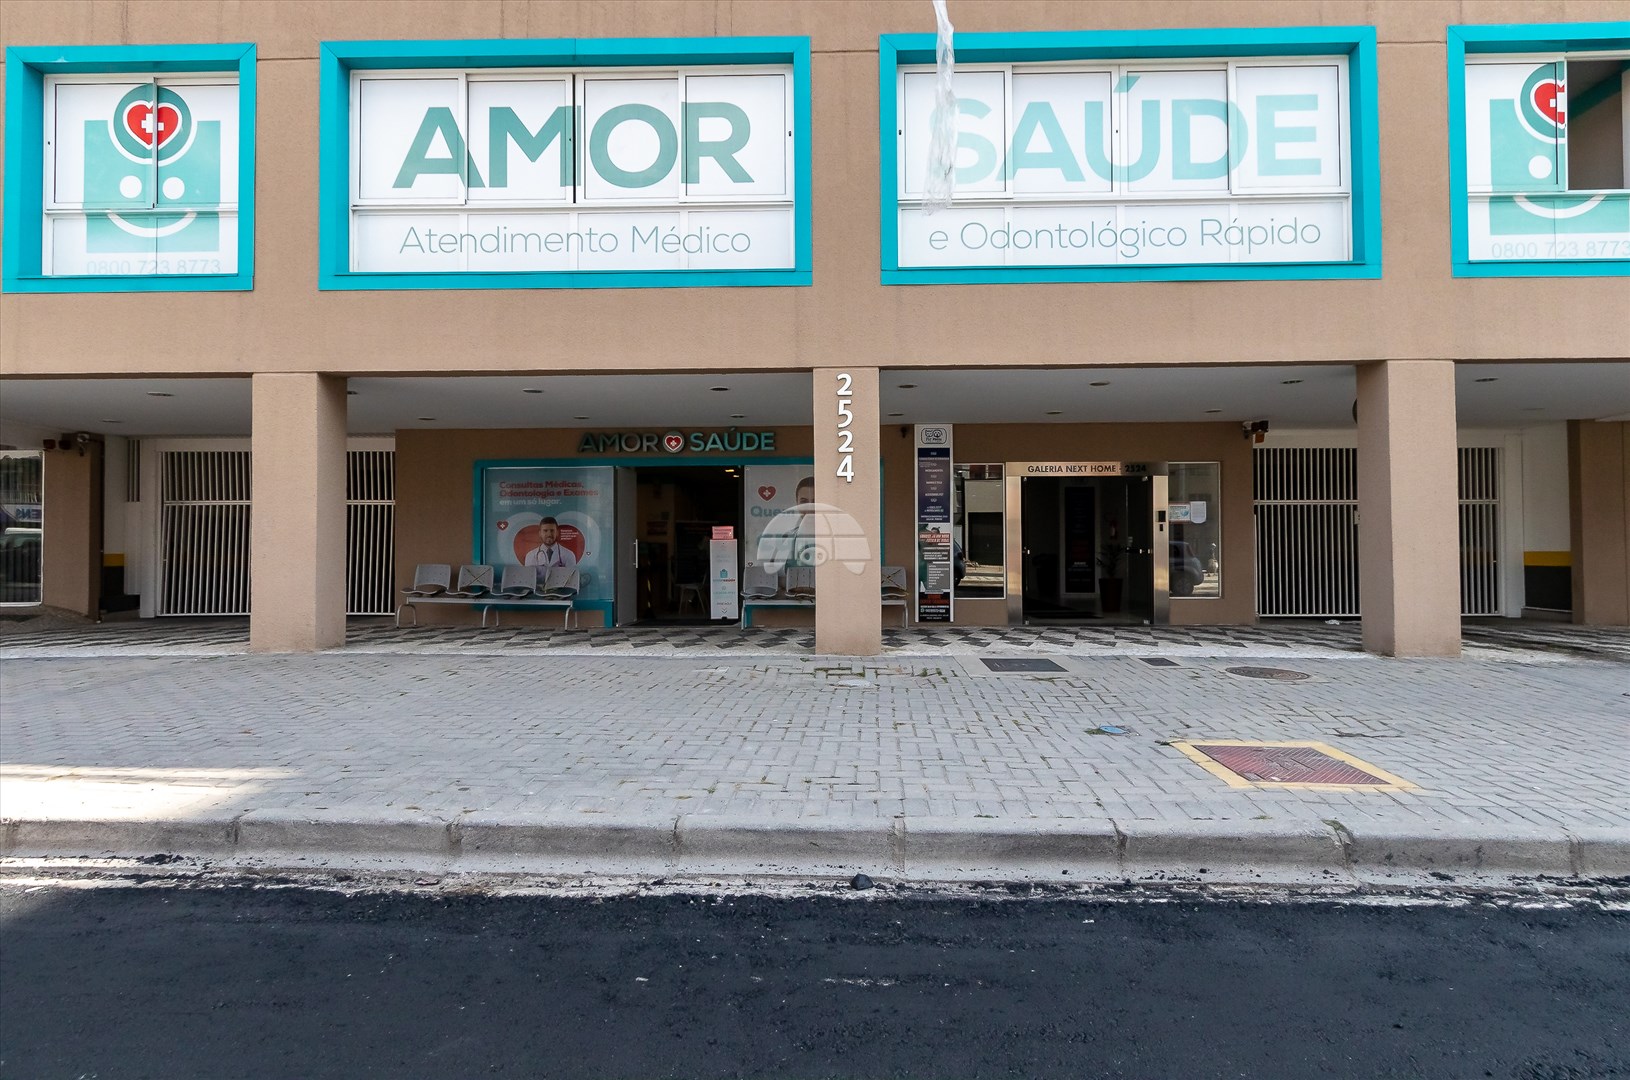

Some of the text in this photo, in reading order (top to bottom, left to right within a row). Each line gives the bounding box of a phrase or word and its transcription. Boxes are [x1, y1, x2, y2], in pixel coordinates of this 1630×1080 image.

[928, 75, 1322, 186] SAÚDE
[392, 101, 755, 189] AMOR
[399, 224, 752, 255] Atendimento Médico
[928, 216, 1322, 258] e Odontológico Rápido
[1491, 240, 1630, 258] 0800 723 8773
[86, 258, 221, 275] 0800 723 8773
[578, 426, 776, 453] AMOR SAÚDE
[836, 373, 855, 483] 2524
[1027, 465, 1063, 473] GALERIA
[1065, 465, 1088, 473] NEXT
[1090, 465, 1117, 473] HOME
[499, 481, 544, 489] Consultas
[750, 505, 795, 518] Que
